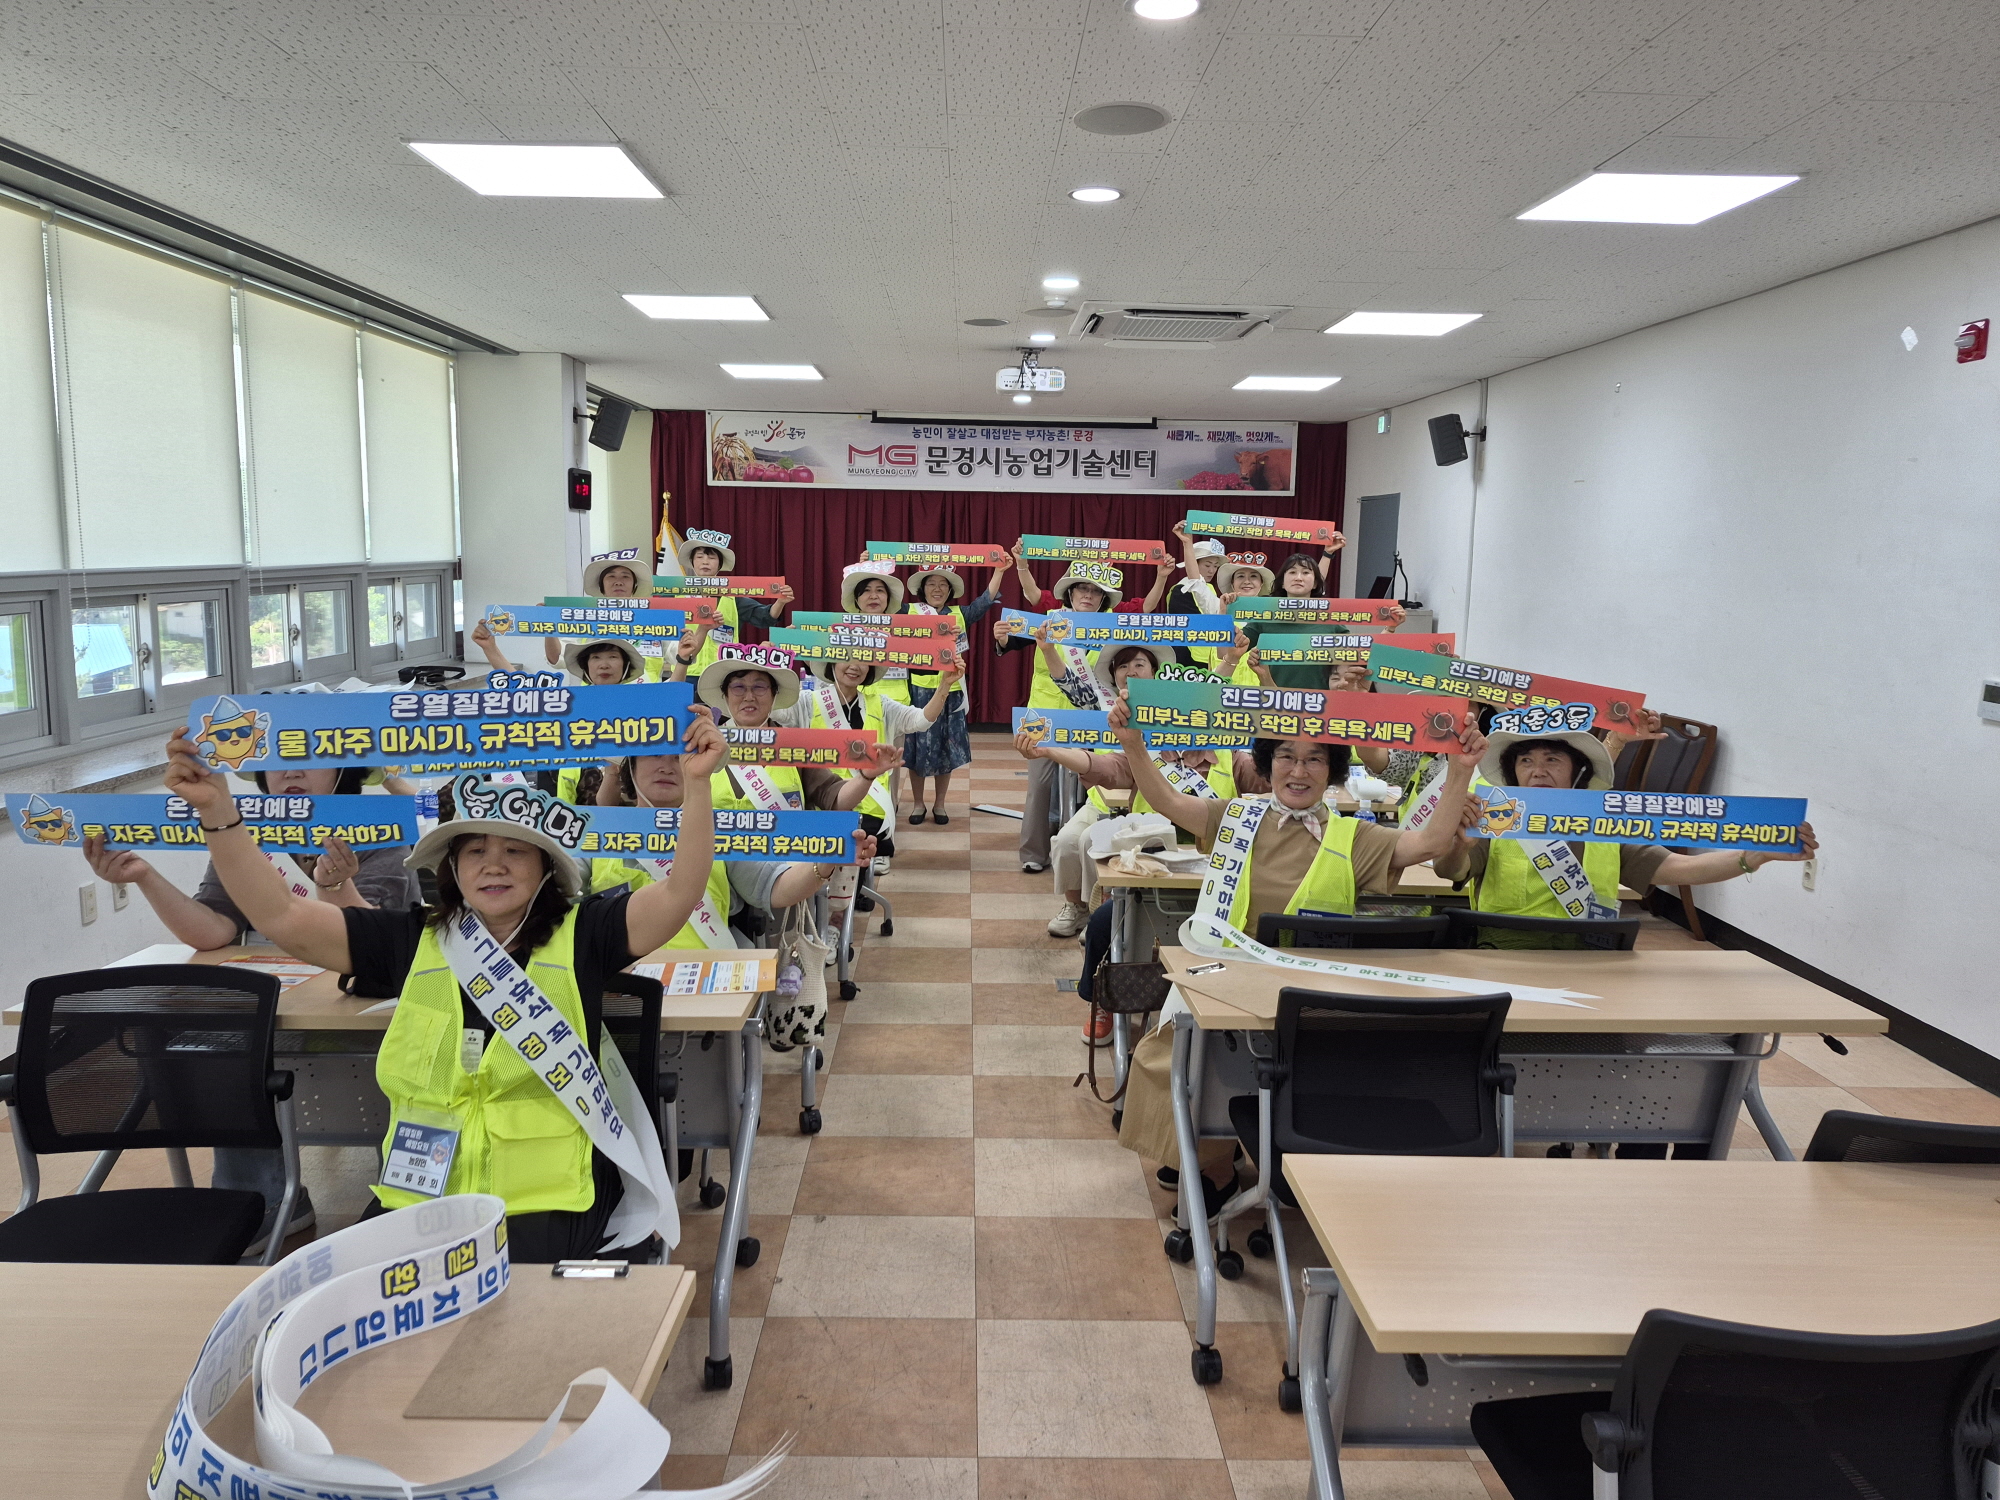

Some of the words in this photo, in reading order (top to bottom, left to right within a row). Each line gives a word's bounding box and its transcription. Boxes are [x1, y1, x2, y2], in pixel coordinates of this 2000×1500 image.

[912, 427, 943, 440] 농민이
[947, 427, 977, 440] 잘살고
[981, 428, 1022, 441] 대접받는
[1025, 429, 1070, 442] 부자농촌!
[1073, 430, 1094, 443] 문경
[848, 444, 918, 466] MG
[924, 446, 1157, 478] 문경시농업기술센터
[1230, 515, 1276, 527] 진드기예방
[1191, 522, 1224, 533] 피부노출
[1226, 525, 1244, 536] 차단,
[1246, 527, 1263, 537] 작업
[1265, 528, 1273, 538] 후
[908, 544, 951, 553] 진드기예방
[1065, 538, 1110, 549] 진드기예방
[873, 553, 904, 562] 피부노출
[905, 554, 923, 563] 차단,
[925, 555, 940, 563] 작업
[942, 555, 950, 563] 후
[1027, 547, 1060, 558] 피부노출
[1062, 549, 1080, 559] 차단,
[1082, 550, 1098, 560] 작업
[1100, 551, 1109, 560] 후
[685, 578, 729, 586] 진드기예방
[682, 587, 700, 595] 차단,
[702, 587, 718, 595] 작업
[597, 598, 650, 609] 진드기예방
[1278, 599, 1330, 610] 진드기예방
[561, 609, 633, 622] 온열질환예방
[842, 614, 891, 625] 진드기예방
[1117, 614, 1189, 627] 온열질환예방
[1234, 610, 1272, 621] 피부노출
[1274, 611, 1296, 622] 차단,
[1298, 611, 1317, 622] 작업
[1319, 612, 1329, 621] 후
[518, 621, 530, 632] 물
[532, 622, 556, 634] 자주
[558, 624, 595, 635] 마시기,
[597, 624, 631, 635] 규칙적
[633, 625, 677, 637] 휴식하기
[1075, 628, 1086, 639] 물
[1088, 628, 1110, 640] 자주
[1113, 629, 1149, 642] 마시기,
[1151, 629, 1185, 642] 규칙적
[1186, 630, 1231, 642] 휴식하기
[829, 634, 887, 648] 진드기예방
[1310, 635, 1373, 648] 진드기예방
[722, 647, 791, 668] 마성면
[779, 643, 823, 657] 피부노출
[825, 647, 849, 661] 차단,
[852, 648, 873, 662] 작업
[876, 650, 886, 662] 후
[1260, 649, 1304, 662] 피부노출
[1306, 650, 1333, 663] 차단,
[1335, 650, 1357, 662] 작업
[1360, 651, 1371, 662] 후
[1449, 661, 1533, 690] 진드기예방
[1377, 665, 1437, 690] 피부노출
[1438, 677, 1473, 698] 차단,
[1477, 686, 1507, 703] 작업
[1510, 691, 1526, 706] 후
[390, 688, 571, 719] 온열질환예방
[1221, 687, 1325, 713] 진드기예방
[1136, 705, 1210, 729] 피부노출
[1212, 711, 1255, 733] 차단,
[1261, 714, 1299, 735] 작업
[1302, 717, 1323, 736] 후
[1328, 719, 1414, 743] 목욕·세탁
[1494, 705, 1592, 733] 점촌3동
[277, 728, 308, 757] 물
[314, 726, 373, 756] 자주
[380, 724, 473, 754] 마시기,
[480, 720, 562, 750] 규칙적
[568, 716, 674, 746] 휴식하기
[719, 729, 777, 744] 기예방
[1054, 728, 1068, 742] 물
[1071, 730, 1099, 743] 자주
[1151, 732, 1191, 747] 규칙적
[1194, 733, 1249, 747] 휴식하기
[730, 747, 757, 762] 작업
[761, 748, 775, 762] 후
[779, 748, 839, 764] 목욕·세탁
[165, 796, 313, 819] 온환예방
[463, 775, 587, 847] 농암면
[1603, 791, 1727, 817] 온열질환예방
[654, 809, 775, 831] 온환예방
[112, 824, 156, 844] 자주
[1527, 814, 1546, 833] 물
[1551, 814, 1589, 836] 자주
[1593, 817, 1655, 840] 마시기,
[1660, 820, 1717, 842] 규칙적
[1721, 822, 1797, 845] 휴식하기
[604, 832, 642, 851] 자주
[772, 834, 843, 855] 휴식하기
[1206, 803, 1245, 896] 염경보!
[546, 1019, 573, 1046] 꼭
[568, 1048, 625, 1141] 기억하세요
